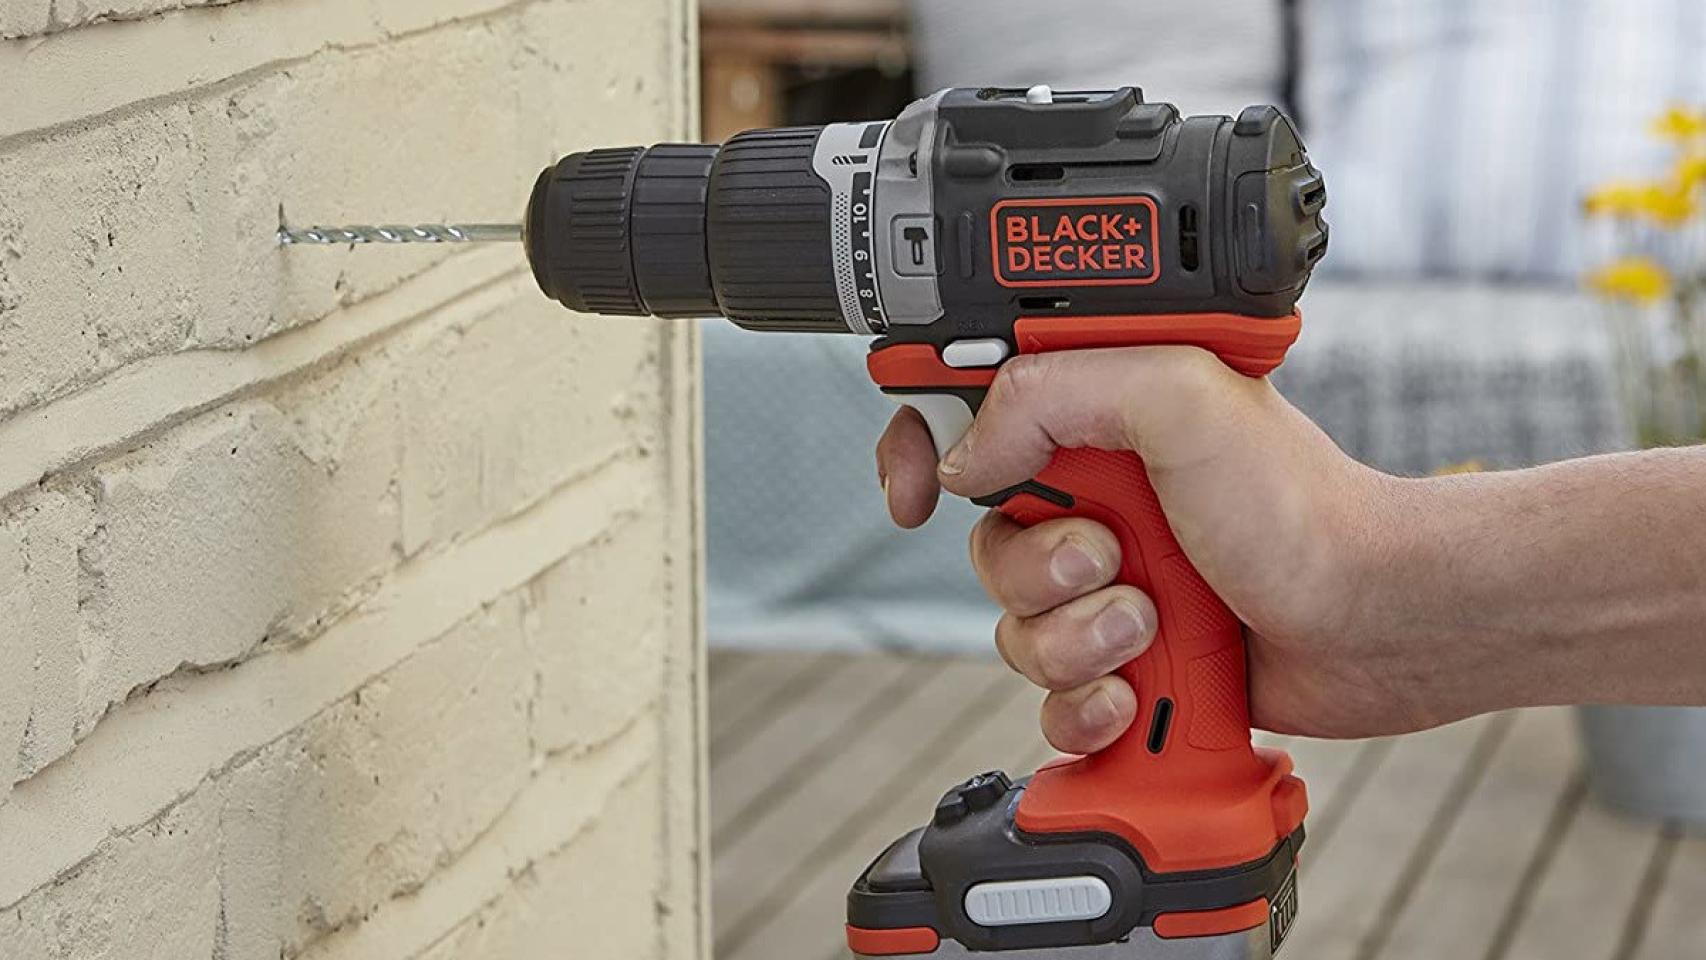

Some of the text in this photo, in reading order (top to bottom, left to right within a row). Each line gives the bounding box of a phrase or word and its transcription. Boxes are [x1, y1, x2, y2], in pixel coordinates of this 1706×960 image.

[853, 203, 867, 223] 10
[1006, 214, 1142, 243] BLACK+
[854, 249, 868, 261] 9
[1007, 243, 1147, 273] DECKER
[860, 289, 874, 298] 8
